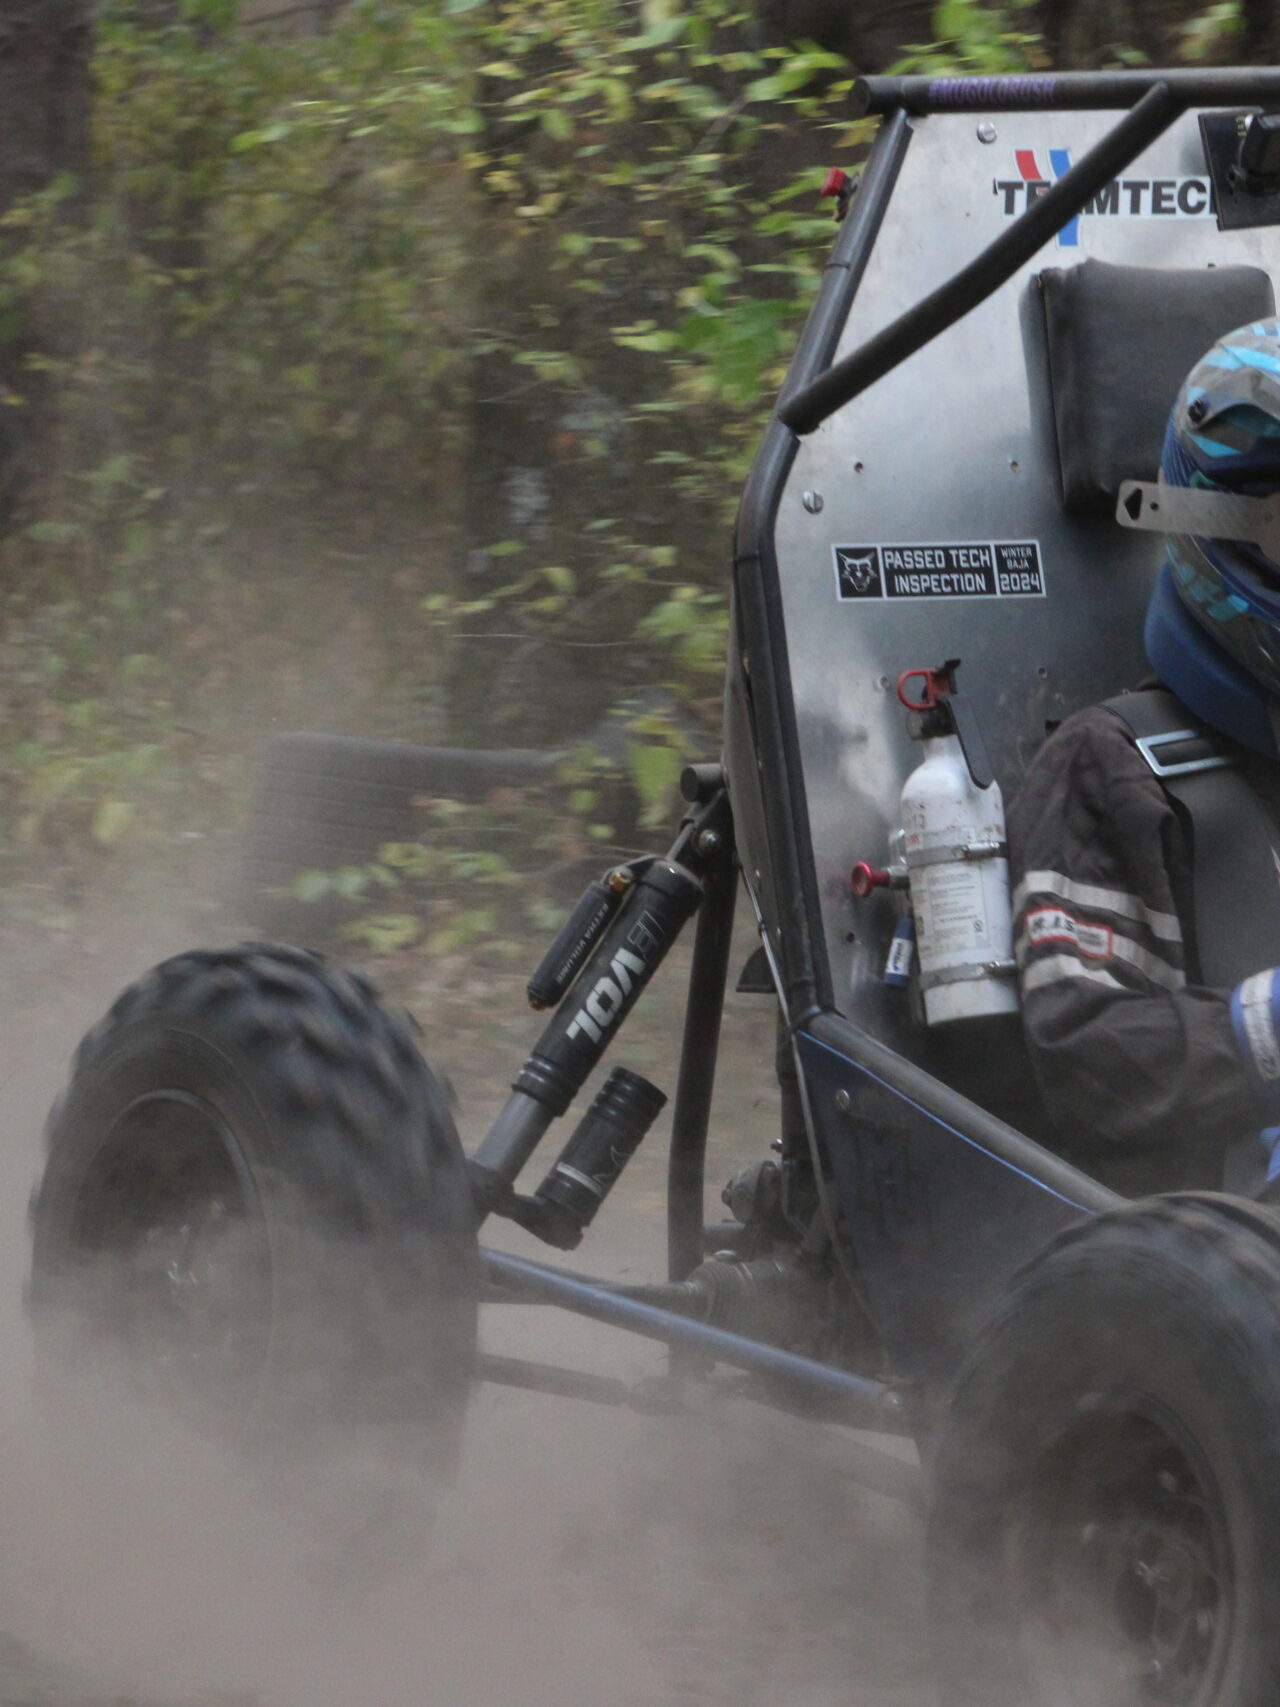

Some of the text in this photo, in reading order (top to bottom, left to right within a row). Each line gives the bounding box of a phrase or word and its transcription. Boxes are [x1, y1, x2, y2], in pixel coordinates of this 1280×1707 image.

[997, 180, 1219, 216] TEMTEC
[884, 548, 991, 569] PASSED TECH
[1000, 546, 1033, 558] WINTER
[1007, 559, 1030, 570] BAJA
[894, 573, 987, 594] INSPECTION
[1000, 572, 1040, 592] 2024
